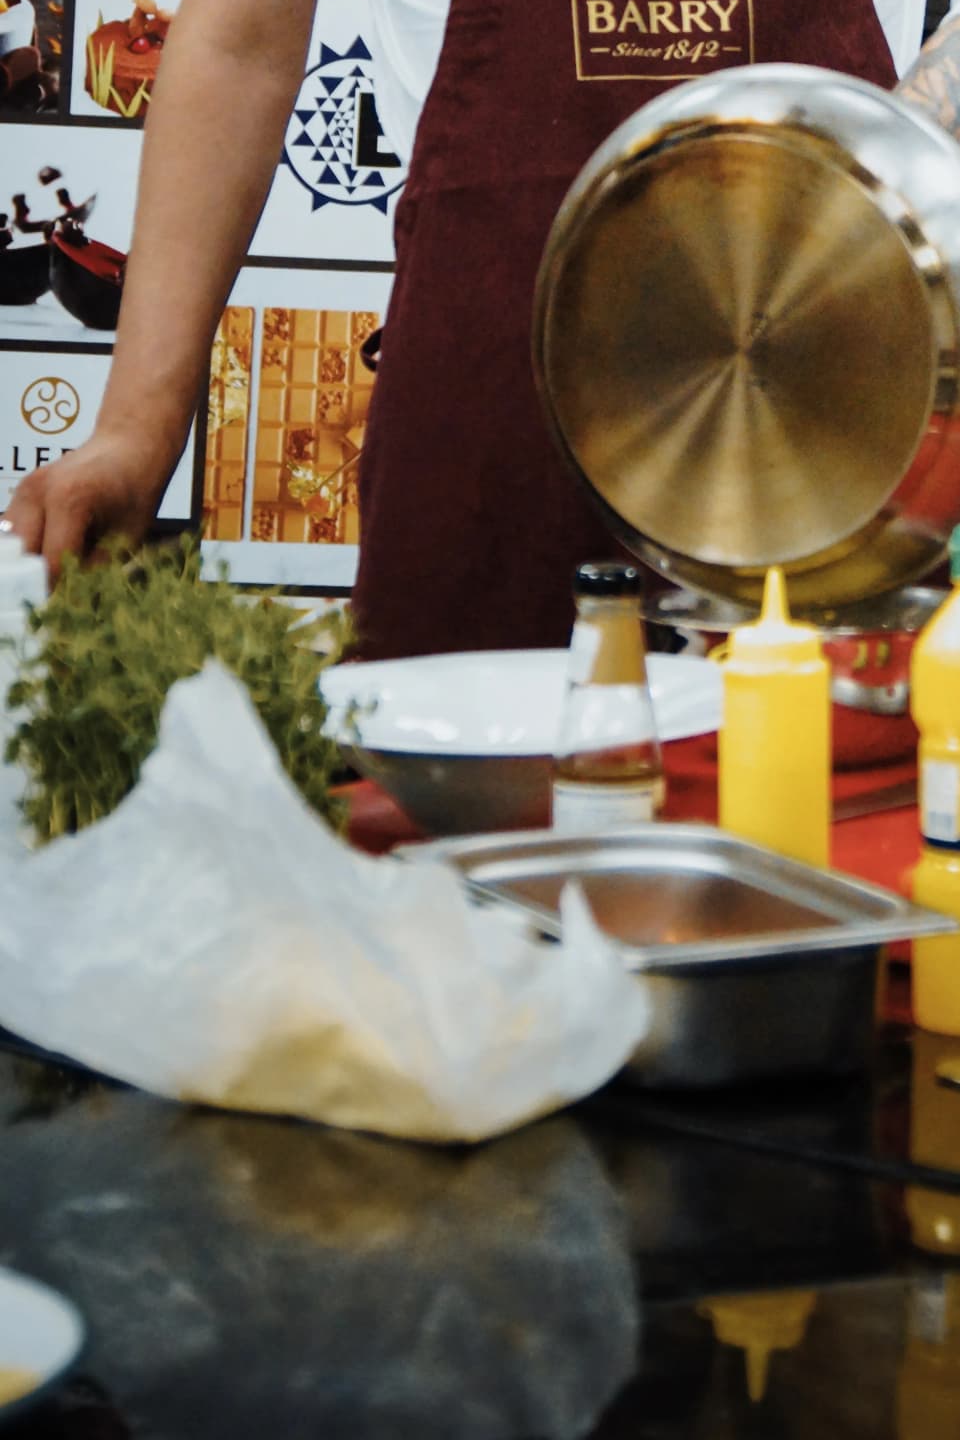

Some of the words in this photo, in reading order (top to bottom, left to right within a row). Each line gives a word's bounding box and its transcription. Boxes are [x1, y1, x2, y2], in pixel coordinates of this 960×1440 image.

[586, 0, 740, 35] BARRY
[612, 41, 662, 58] Since
[663, 39, 721, 64] 1842
